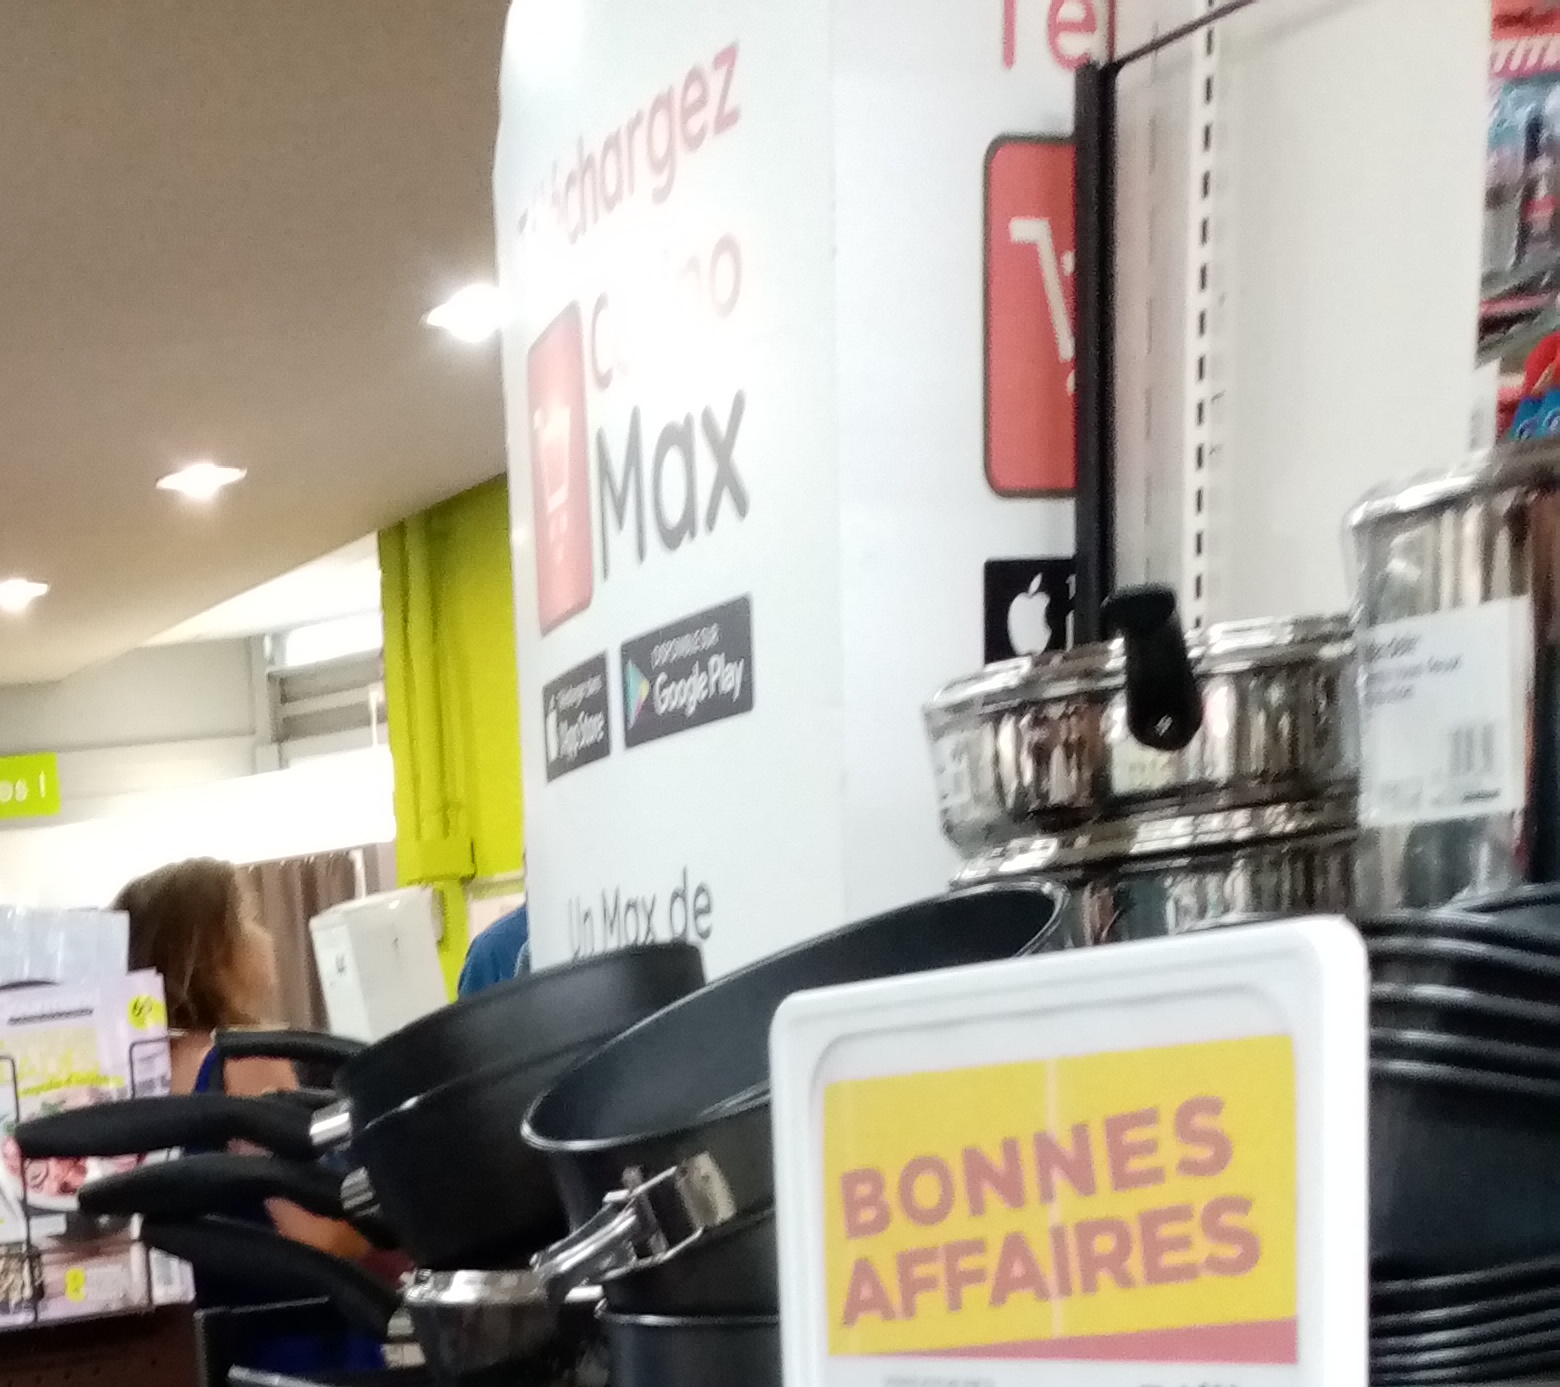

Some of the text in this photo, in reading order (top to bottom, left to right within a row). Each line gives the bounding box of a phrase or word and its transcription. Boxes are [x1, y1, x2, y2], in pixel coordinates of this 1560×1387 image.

[596, 388, 749, 583] Max
[653, 660, 709, 718] Google
[707, 652, 745, 703] Play
[602, 884, 656, 949] Max
[670, 864, 713, 941] de
[841, 1096, 1234, 1240] BONNES
[842, 1195, 1261, 1328] AFFAIRES
